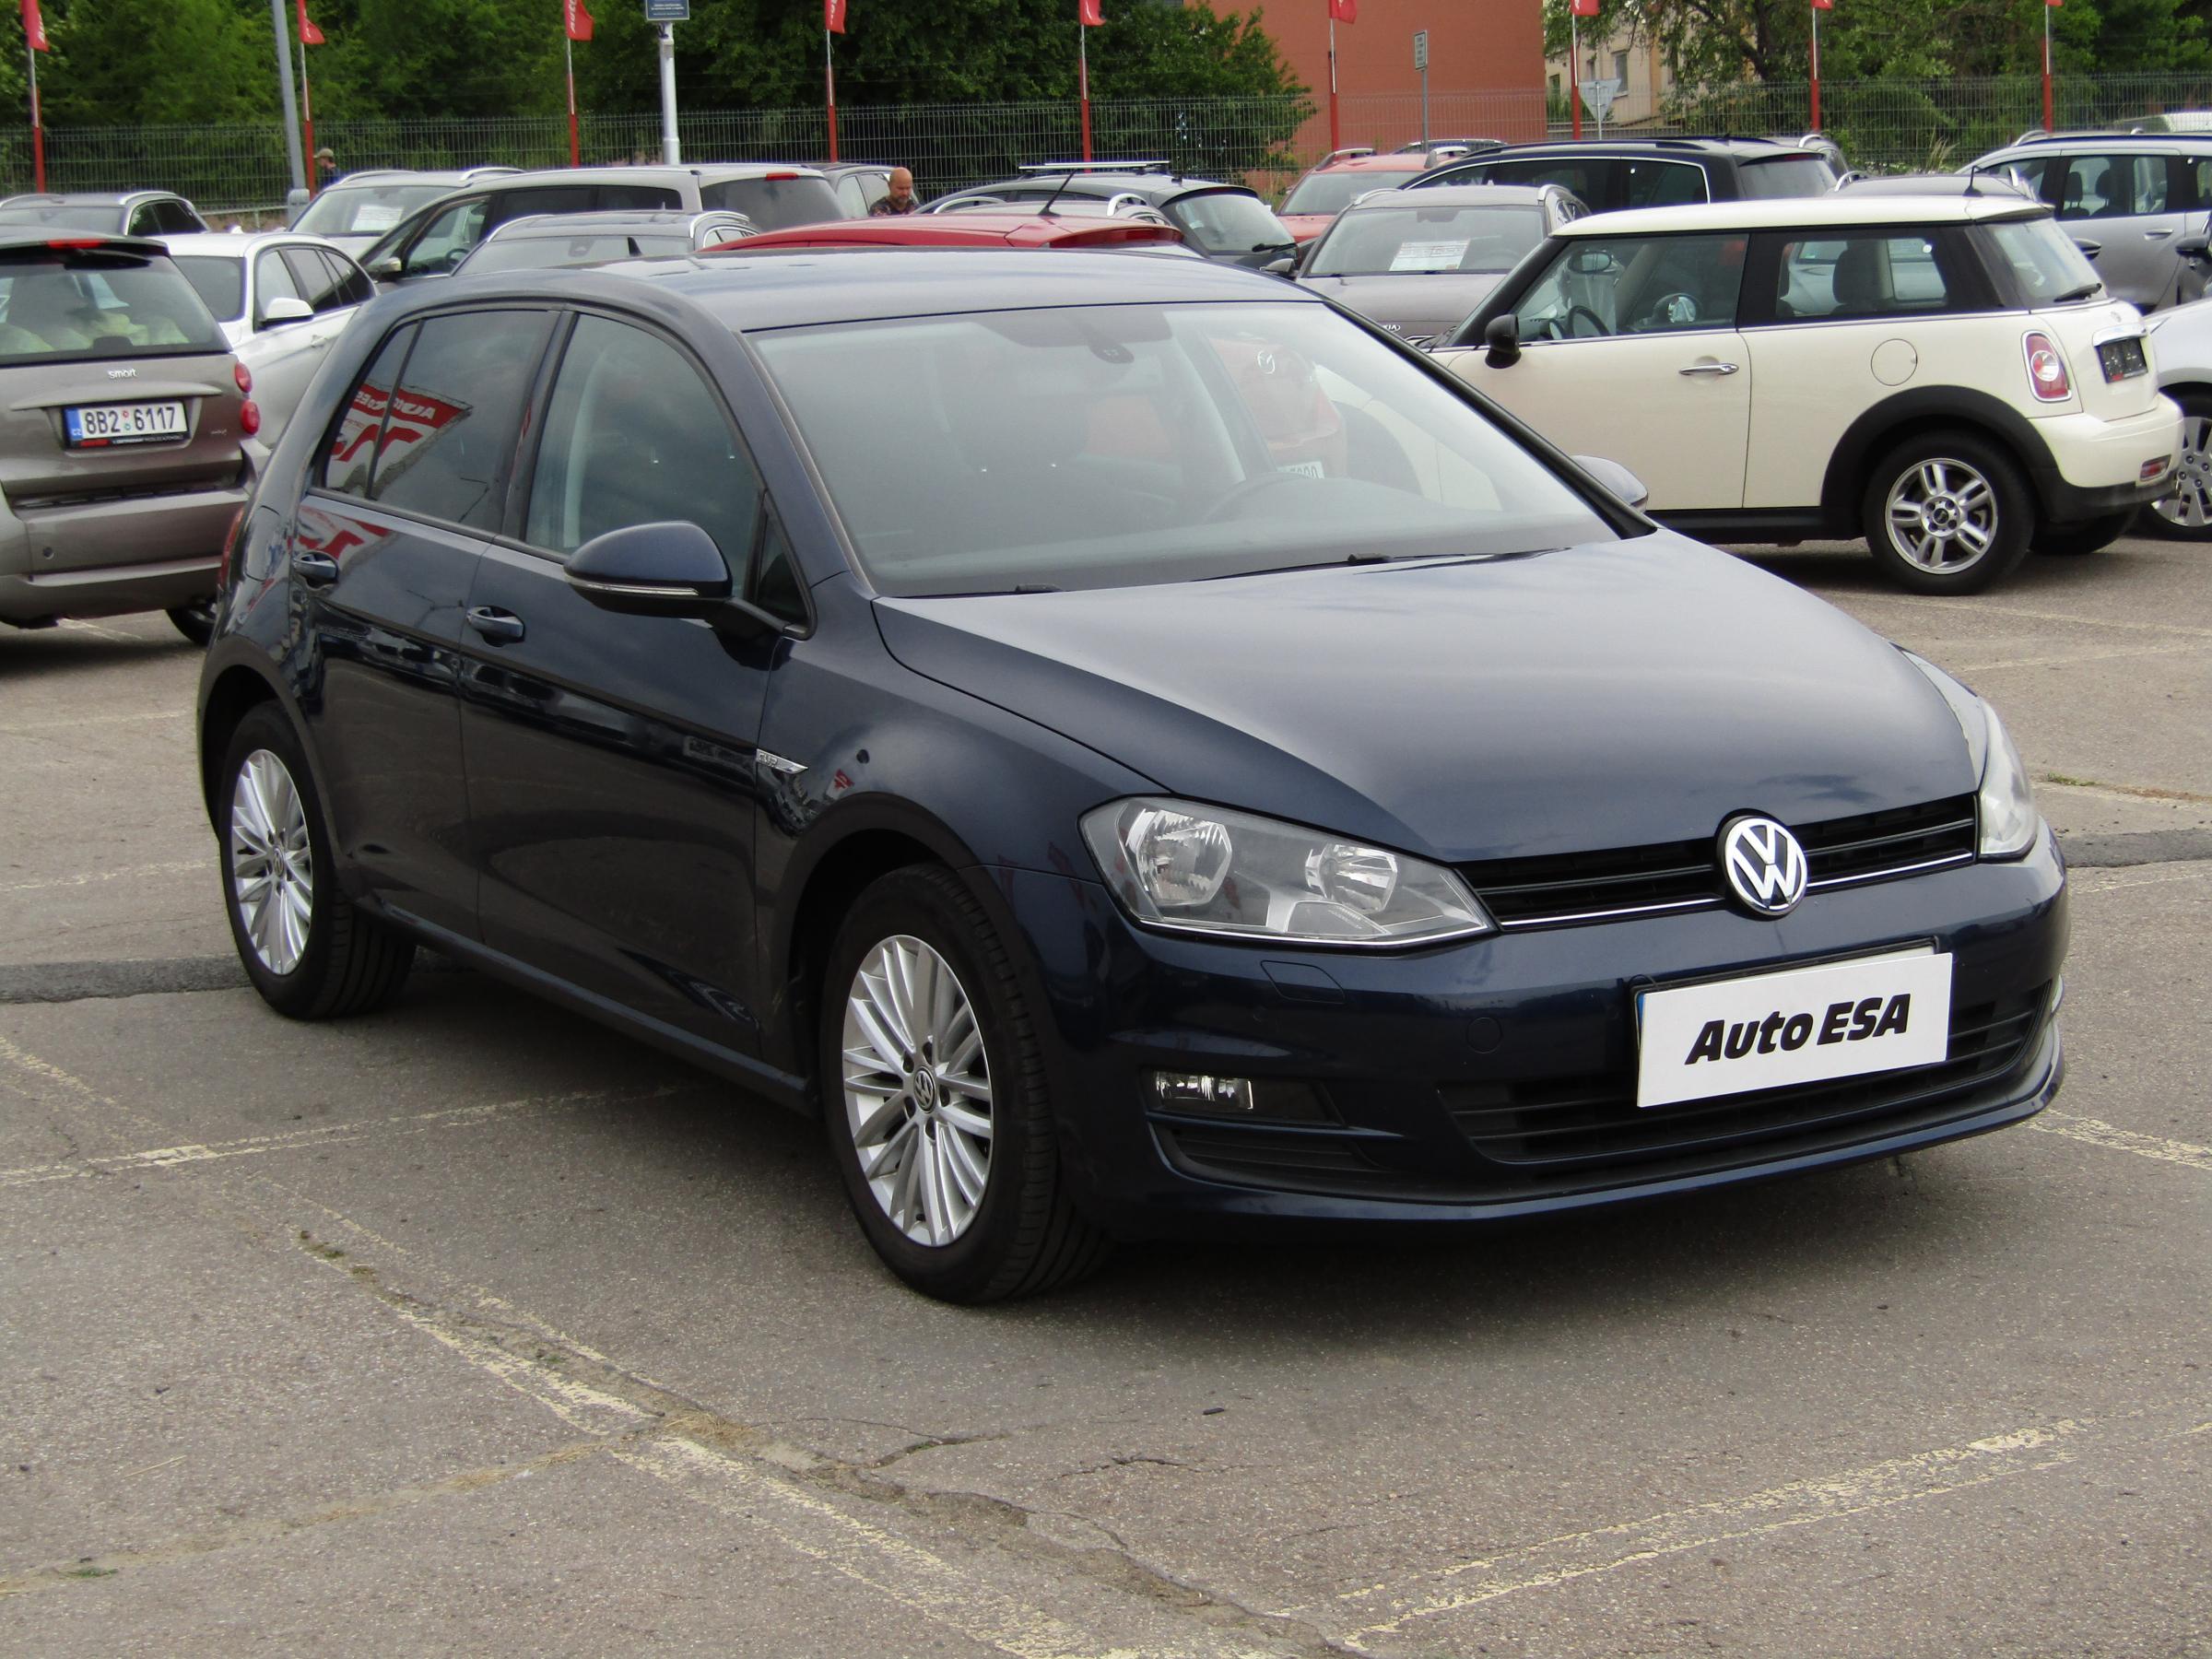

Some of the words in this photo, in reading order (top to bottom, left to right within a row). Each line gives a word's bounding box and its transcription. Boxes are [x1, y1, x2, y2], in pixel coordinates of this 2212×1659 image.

[108, 368, 137, 379] smart
[85, 409, 121, 435] 8B2
[134, 406, 175, 431] 6117
[1684, 1010, 1814, 1065] Auto
[1816, 993, 1912, 1046] ESA
